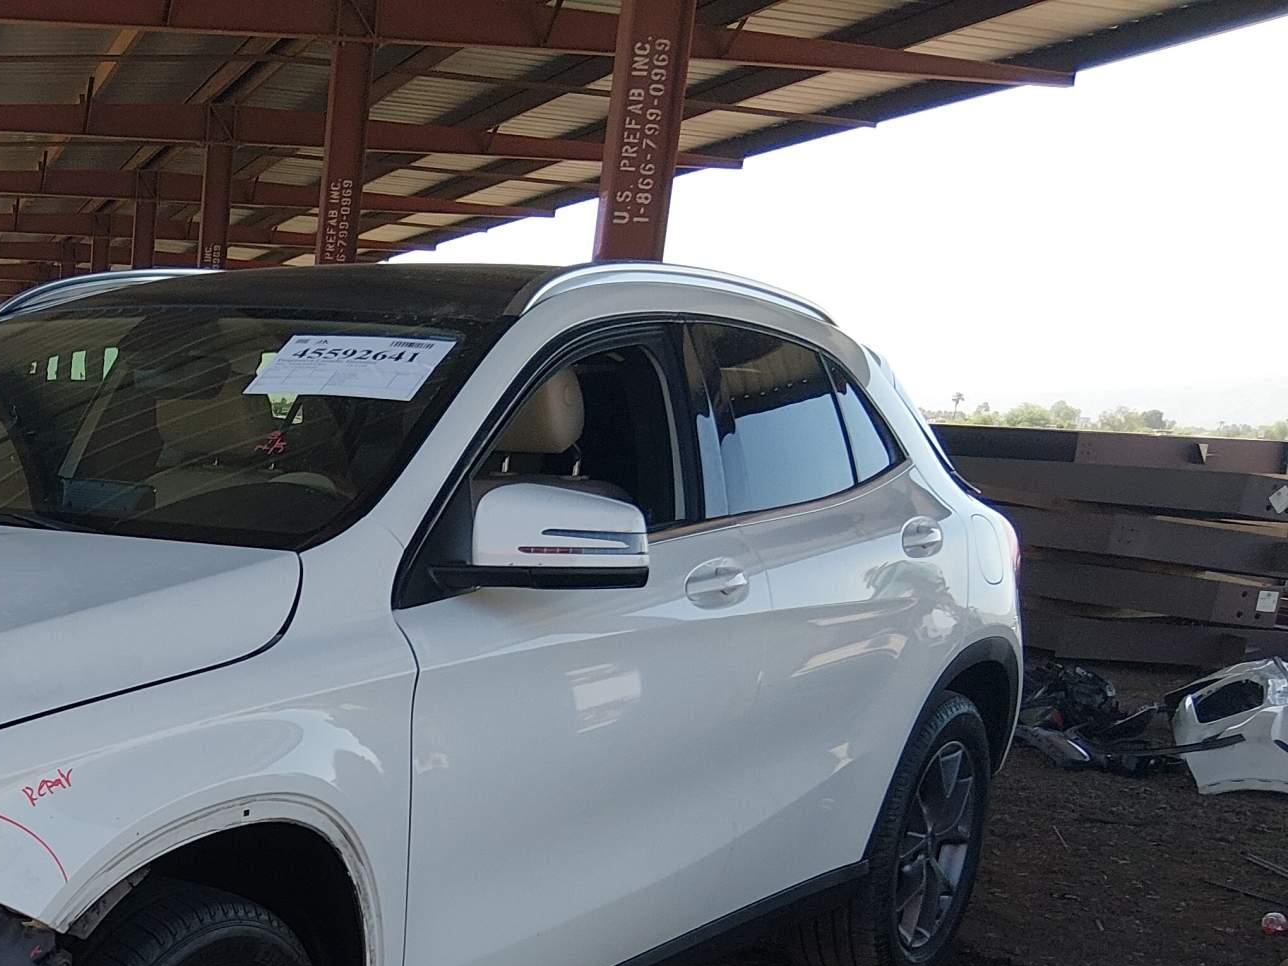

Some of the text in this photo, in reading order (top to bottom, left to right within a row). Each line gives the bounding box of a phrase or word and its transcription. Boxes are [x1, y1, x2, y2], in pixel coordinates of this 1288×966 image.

[613, 36, 653, 224] U.S. PREFAB INC.
[633, 39, 671, 223] 1-866-799-0969
[324, 210, 338, 260] PREFAB
[292, 347, 420, 363] 45592641
